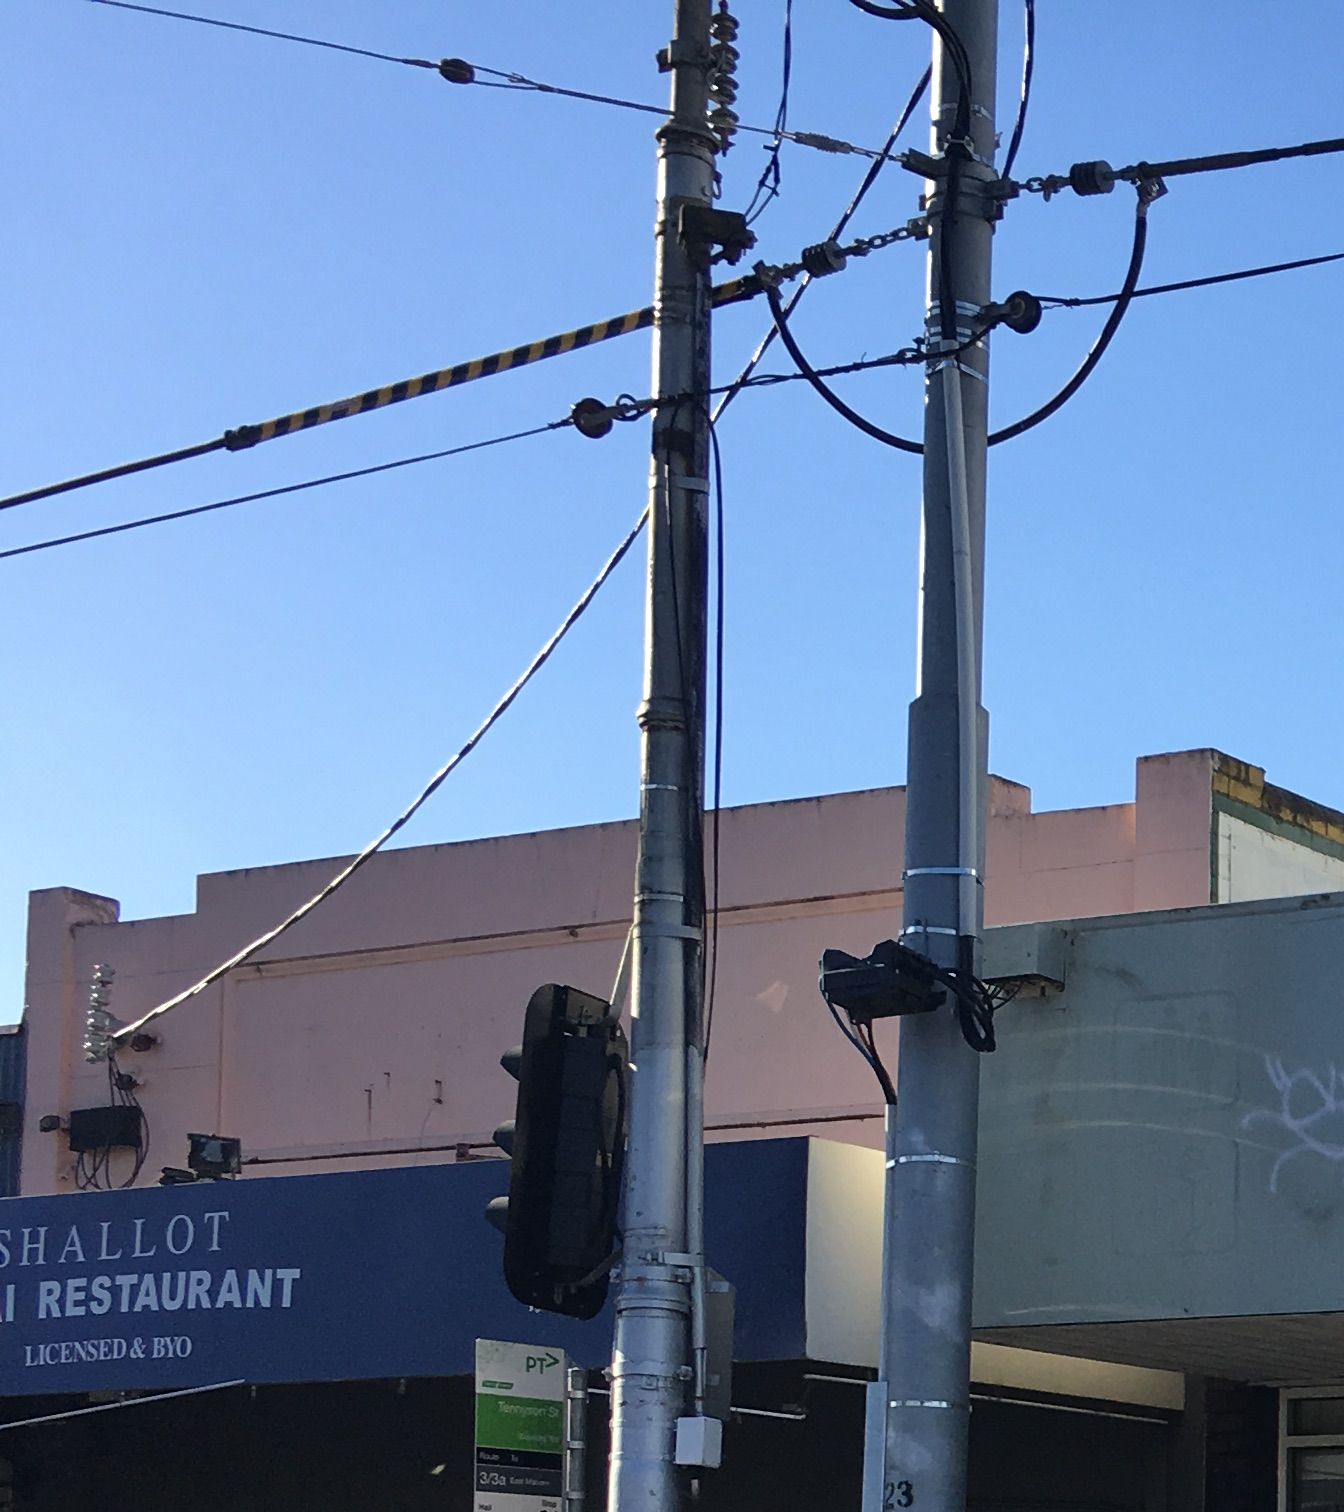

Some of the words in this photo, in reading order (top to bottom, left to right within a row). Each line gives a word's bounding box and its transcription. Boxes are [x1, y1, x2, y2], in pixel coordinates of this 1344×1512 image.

[0, 1211, 230, 1268] SHALLOT
[38, 1268, 301, 1320] RESTAURANT
[24, 1337, 127, 1367] LICENSED
[129, 1336, 146, 1360] &
[151, 1335, 193, 1359] BYO
[479, 1471, 507, 1487] 3/3a
